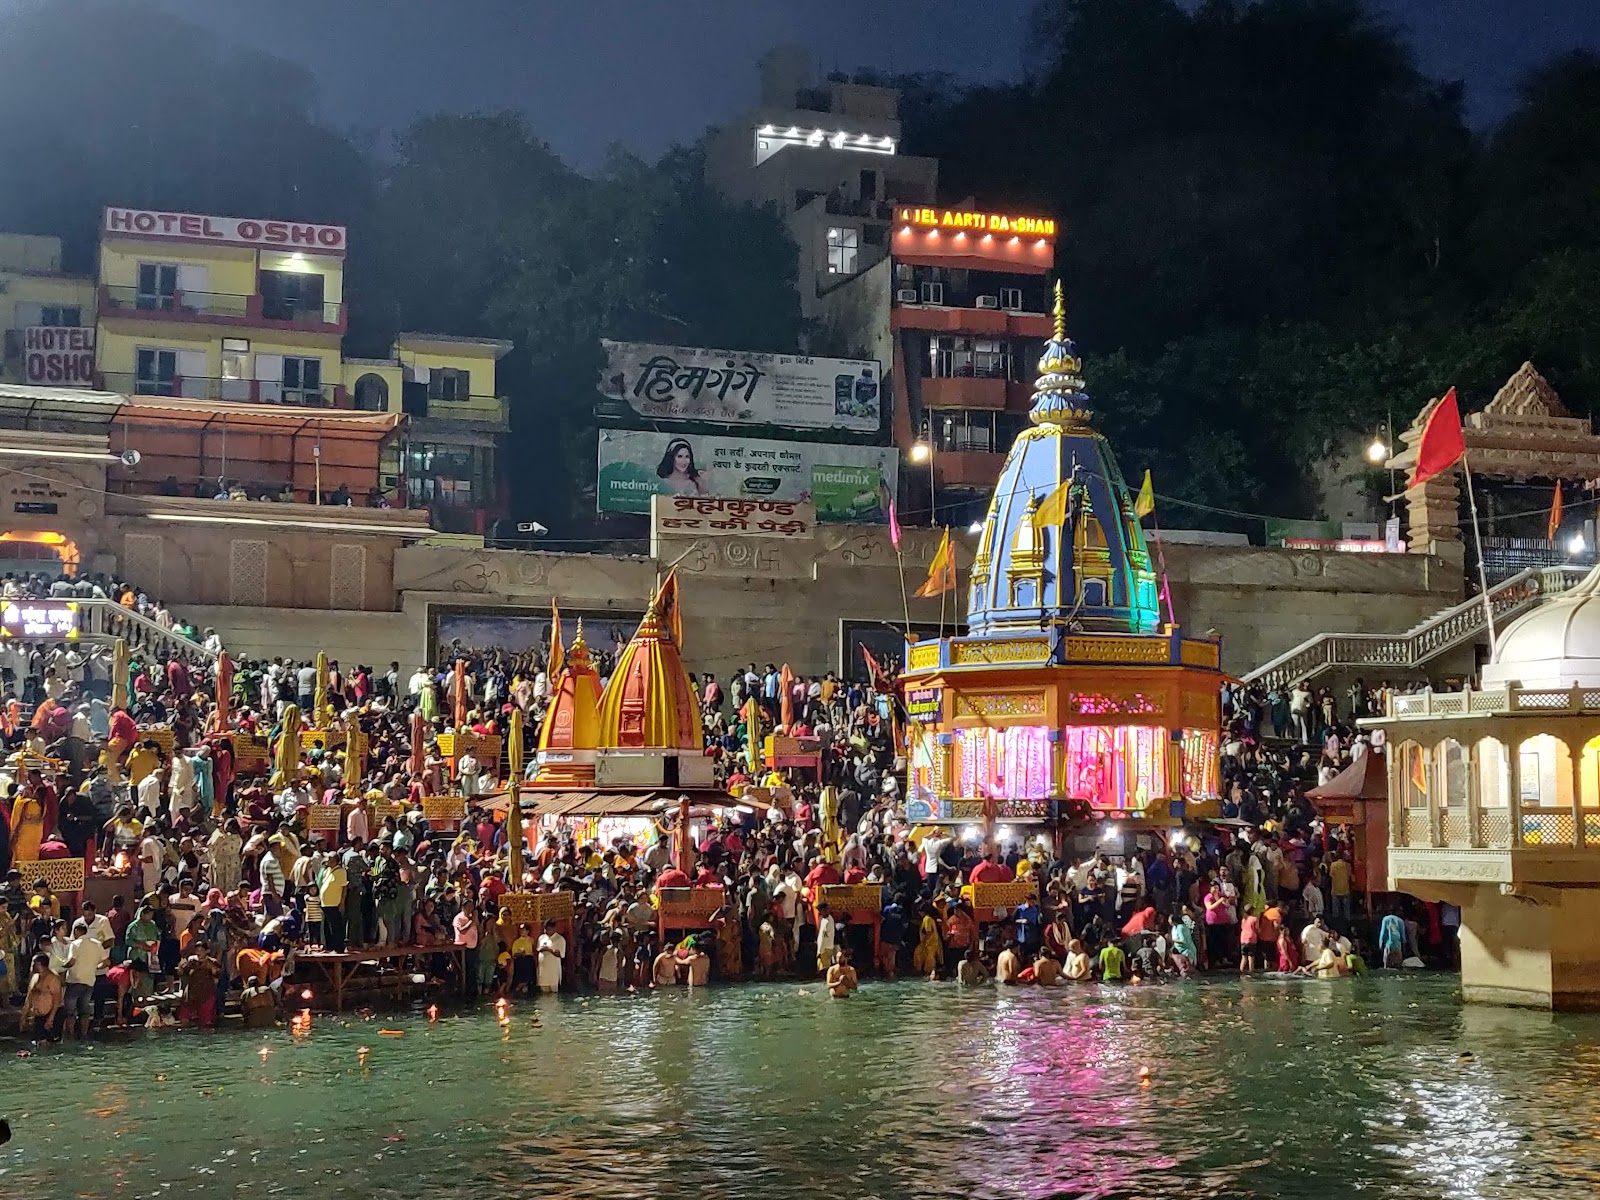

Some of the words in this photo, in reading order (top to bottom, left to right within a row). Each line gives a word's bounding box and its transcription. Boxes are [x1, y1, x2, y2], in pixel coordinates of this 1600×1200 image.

[111, 210, 224, 238] HOTEL
[237, 221, 342, 247] OSHO
[898, 207, 939, 225] OTEL
[943, 211, 986, 229] AARTI
[27, 328, 94, 351] HOTEL
[28, 353, 96, 382] OSHO
[633, 355, 767, 403] हिमगंगे
[734, 459, 742, 469] के
[610, 479, 659, 491] medimix
[812, 469, 870, 485] medimix
[673, 496, 800, 517] ब्रह्मकुण्ड
[661, 517, 703, 529] हर
[709, 517, 750, 530] की
